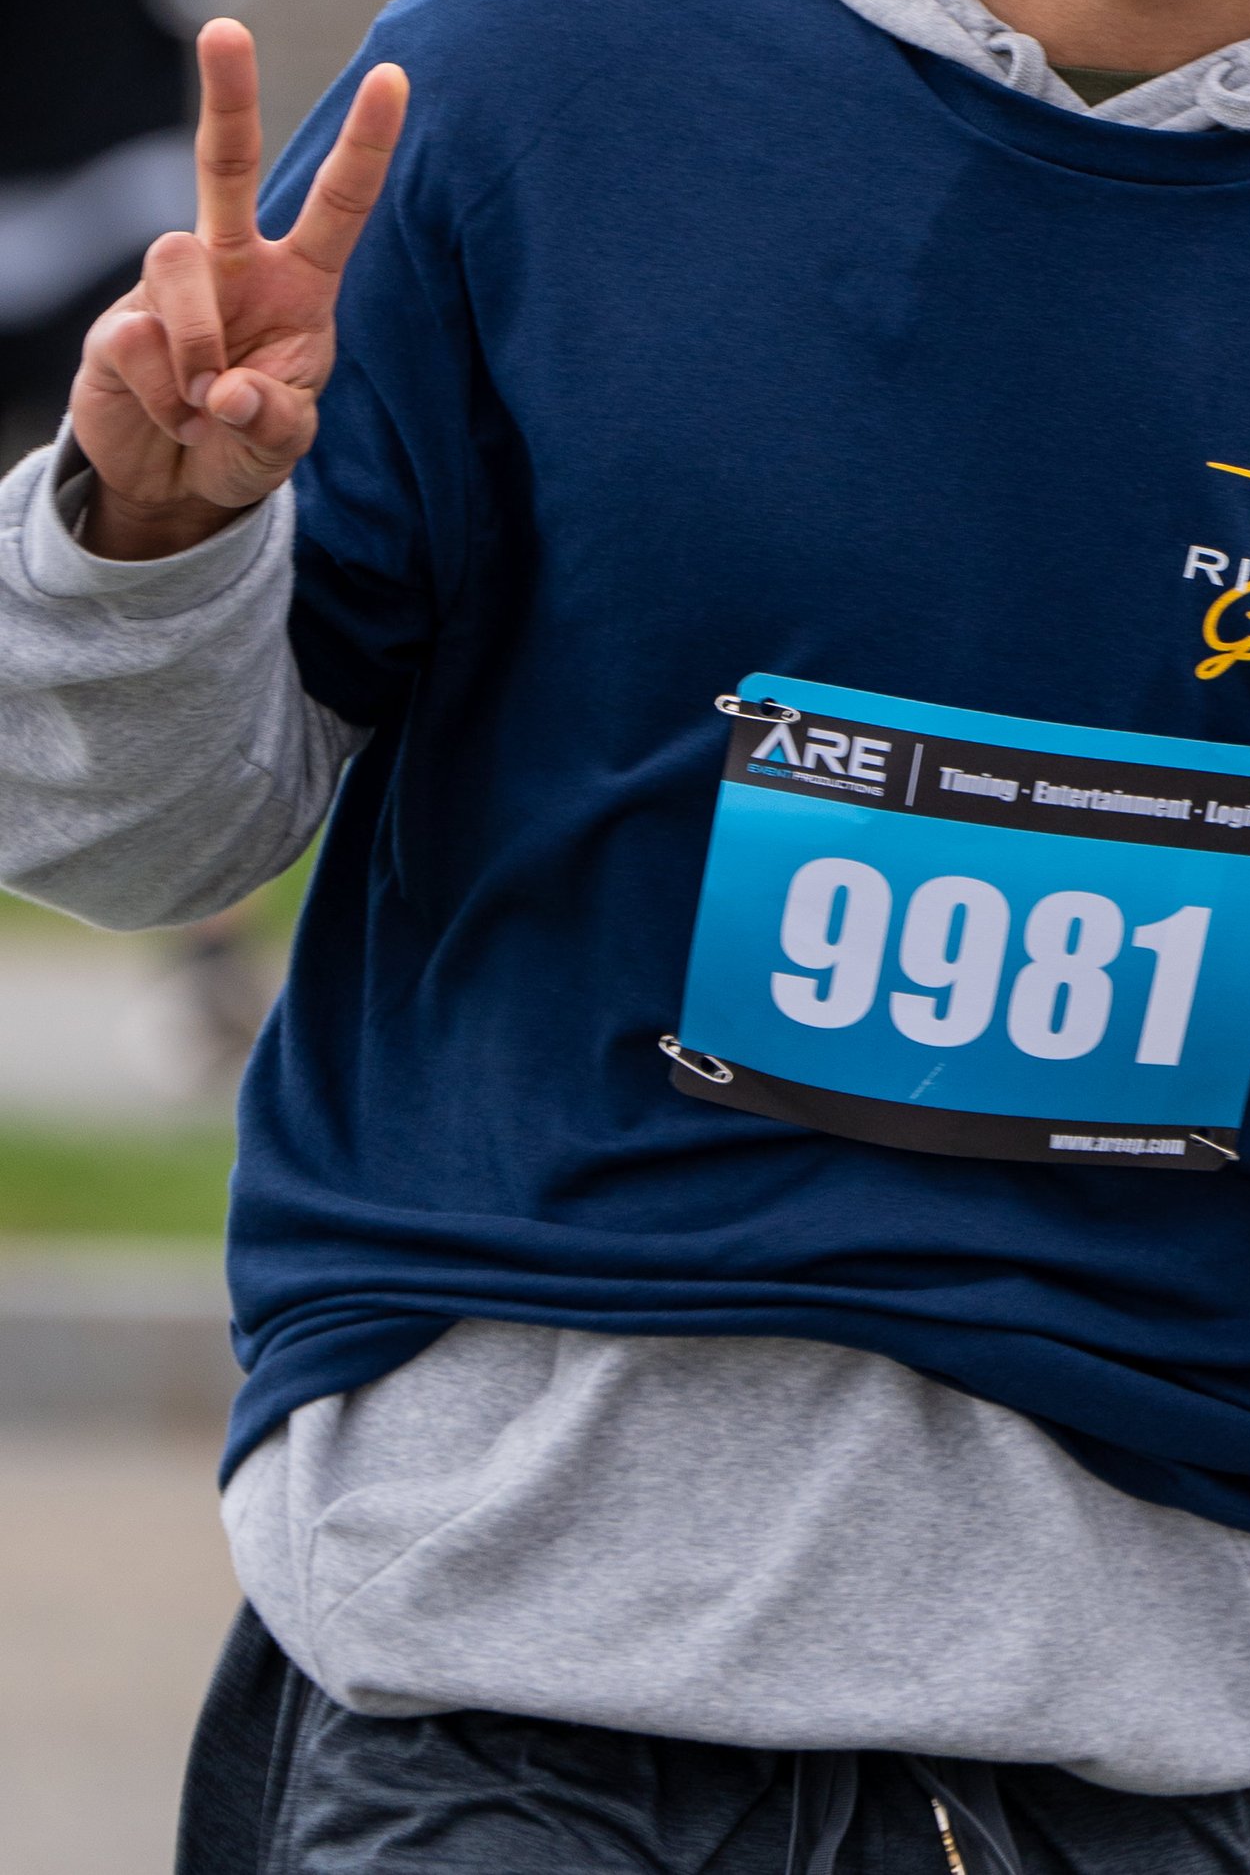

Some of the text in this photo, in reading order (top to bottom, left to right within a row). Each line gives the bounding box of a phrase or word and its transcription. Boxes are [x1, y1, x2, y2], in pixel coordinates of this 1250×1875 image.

[750, 722, 892, 782] ARE
[939, 766, 1020, 803] Timing
[1031, 780, 1192, 820] Entertainment
[769, 856, 1213, 1067] 9981
